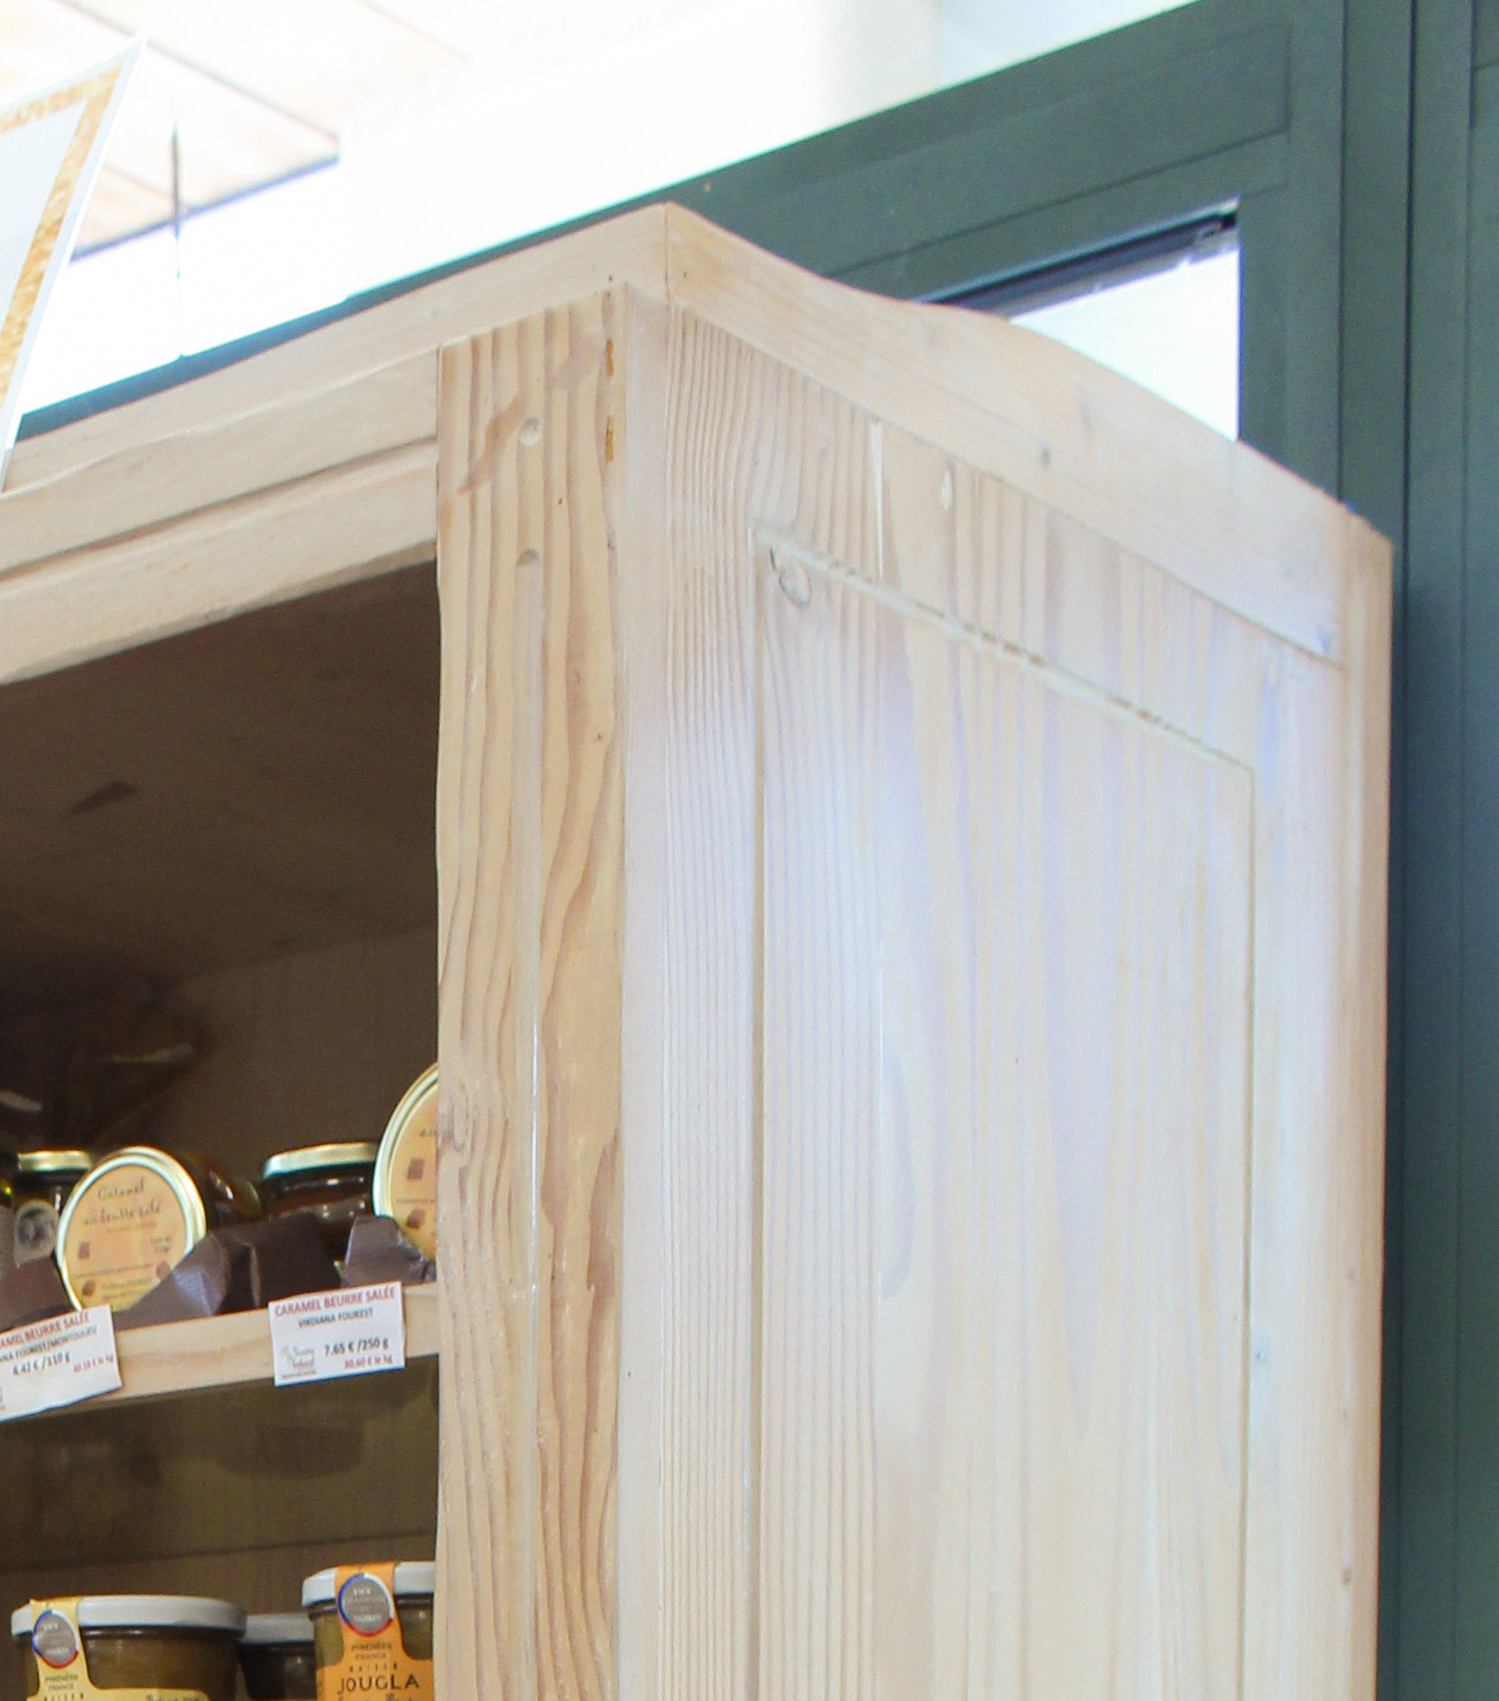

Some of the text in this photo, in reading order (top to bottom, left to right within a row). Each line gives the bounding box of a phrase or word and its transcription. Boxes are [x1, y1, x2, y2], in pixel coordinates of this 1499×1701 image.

[275, 1286, 394, 1316] CARAMEL BEURRE SALÉE
[25, 1319, 61, 1341] BEURRE
[337, 1674, 420, 1695] JOUGLA
